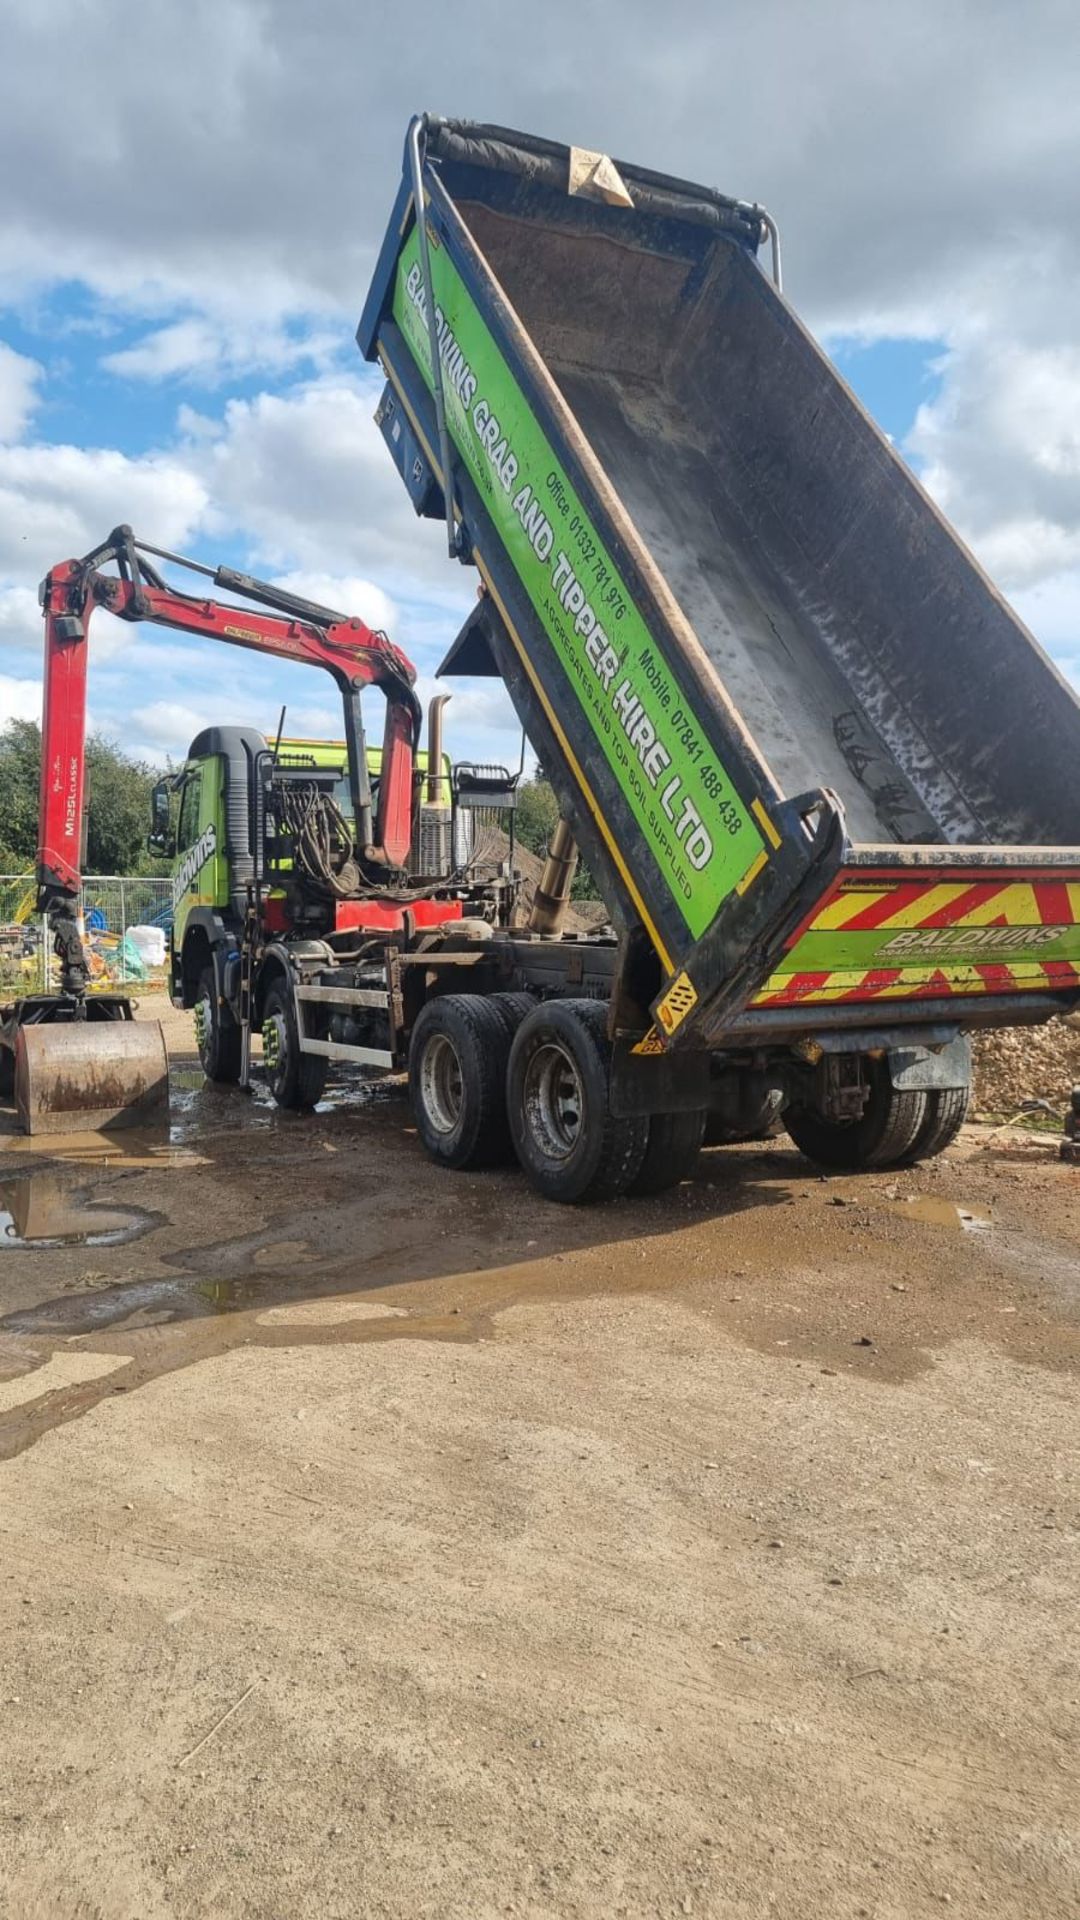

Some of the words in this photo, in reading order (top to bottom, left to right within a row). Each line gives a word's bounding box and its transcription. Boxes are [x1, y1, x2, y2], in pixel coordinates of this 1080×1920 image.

[472, 398, 519, 495] GRAB
[511, 484, 554, 563] AND
[551, 548, 620, 696] TIPPER
[611, 678, 673, 791] HIRE
[660, 772, 714, 872] LTD
[543, 598, 594, 700] AGGREGATES
[592, 699, 612, 735] AND
[612, 731, 629, 768] TOP
[628, 769, 648, 815] SOIL
[648, 809, 693, 900] SUPPLIED
[569, 516, 597, 564] 01332
[591, 557, 612, 590] 781
[606, 587, 627, 621] 976
[671, 709, 704, 764] 07841
[699, 765, 723, 799] 488
[718, 800, 742, 836] 438
[882, 926, 1069, 950] BALDWINS
